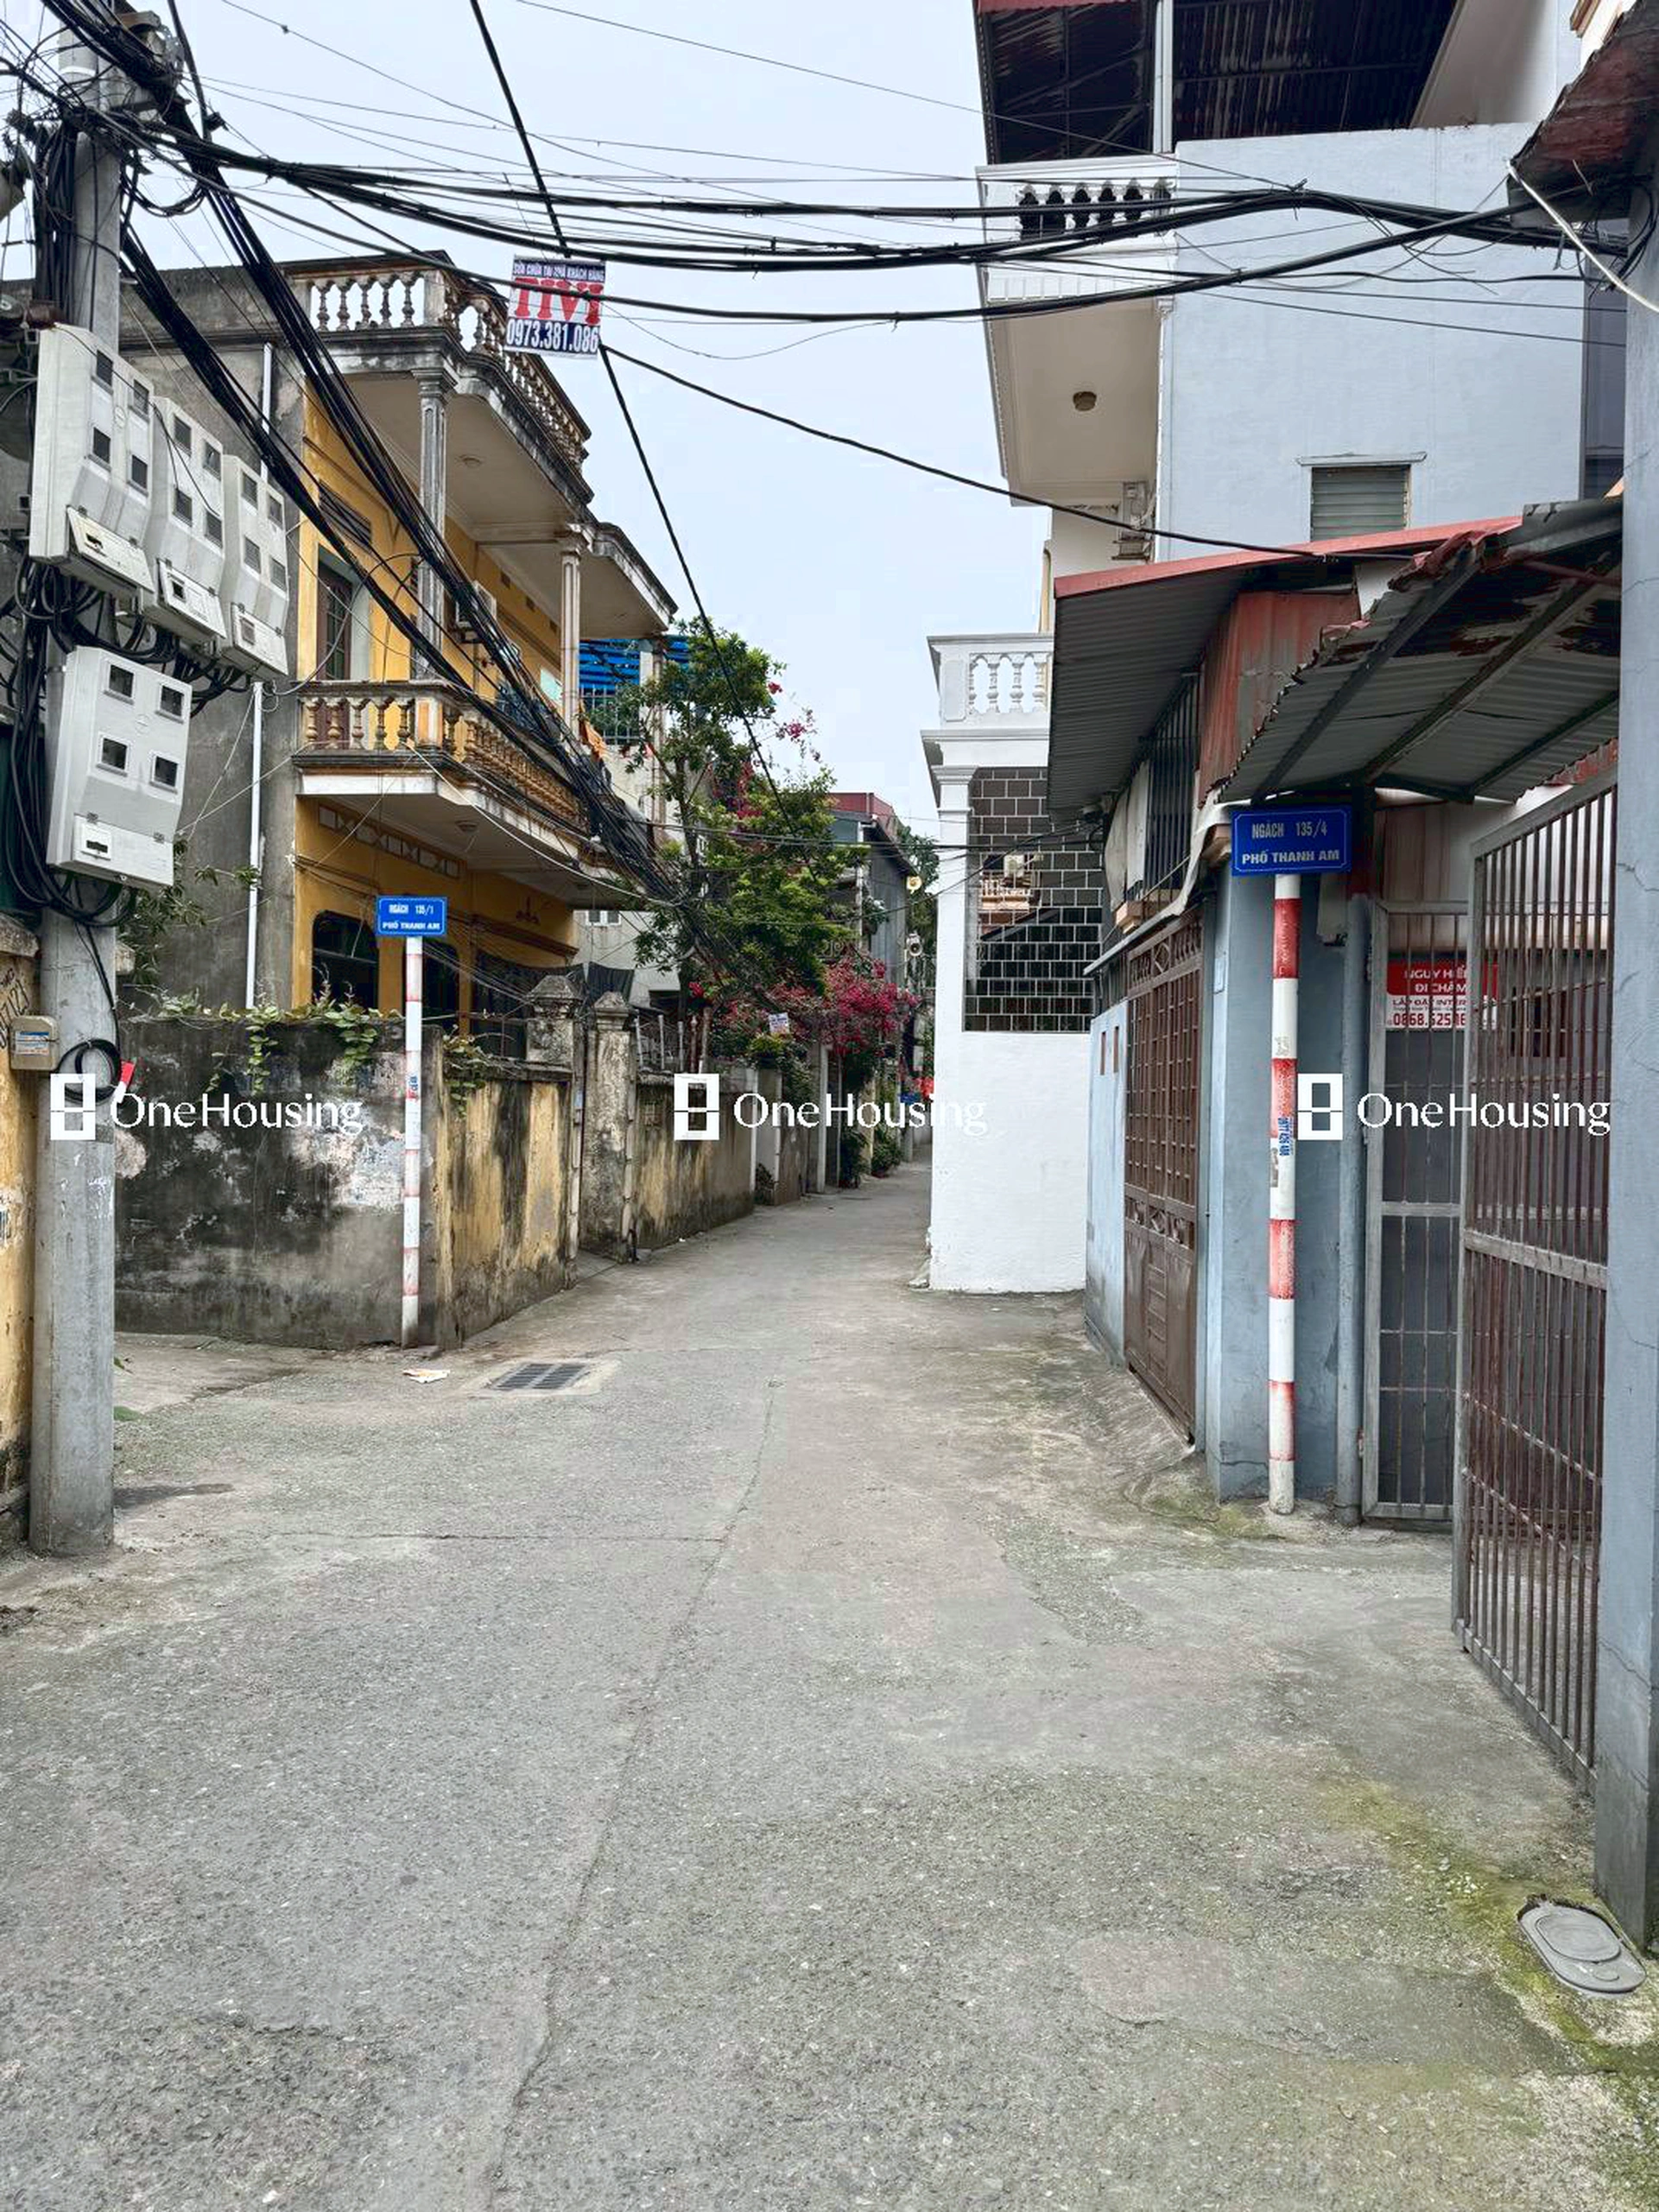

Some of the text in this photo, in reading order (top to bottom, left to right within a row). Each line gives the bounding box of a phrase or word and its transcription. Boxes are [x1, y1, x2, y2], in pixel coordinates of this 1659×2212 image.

[515, 277, 604, 326] TIVI
[507, 319, 598, 352] 0973.381.086
[1296, 818, 1327, 838] 135/4
[1242, 849, 1339, 865] PHỐ THANH AM
[383, 921, 398, 929] PHỐ
